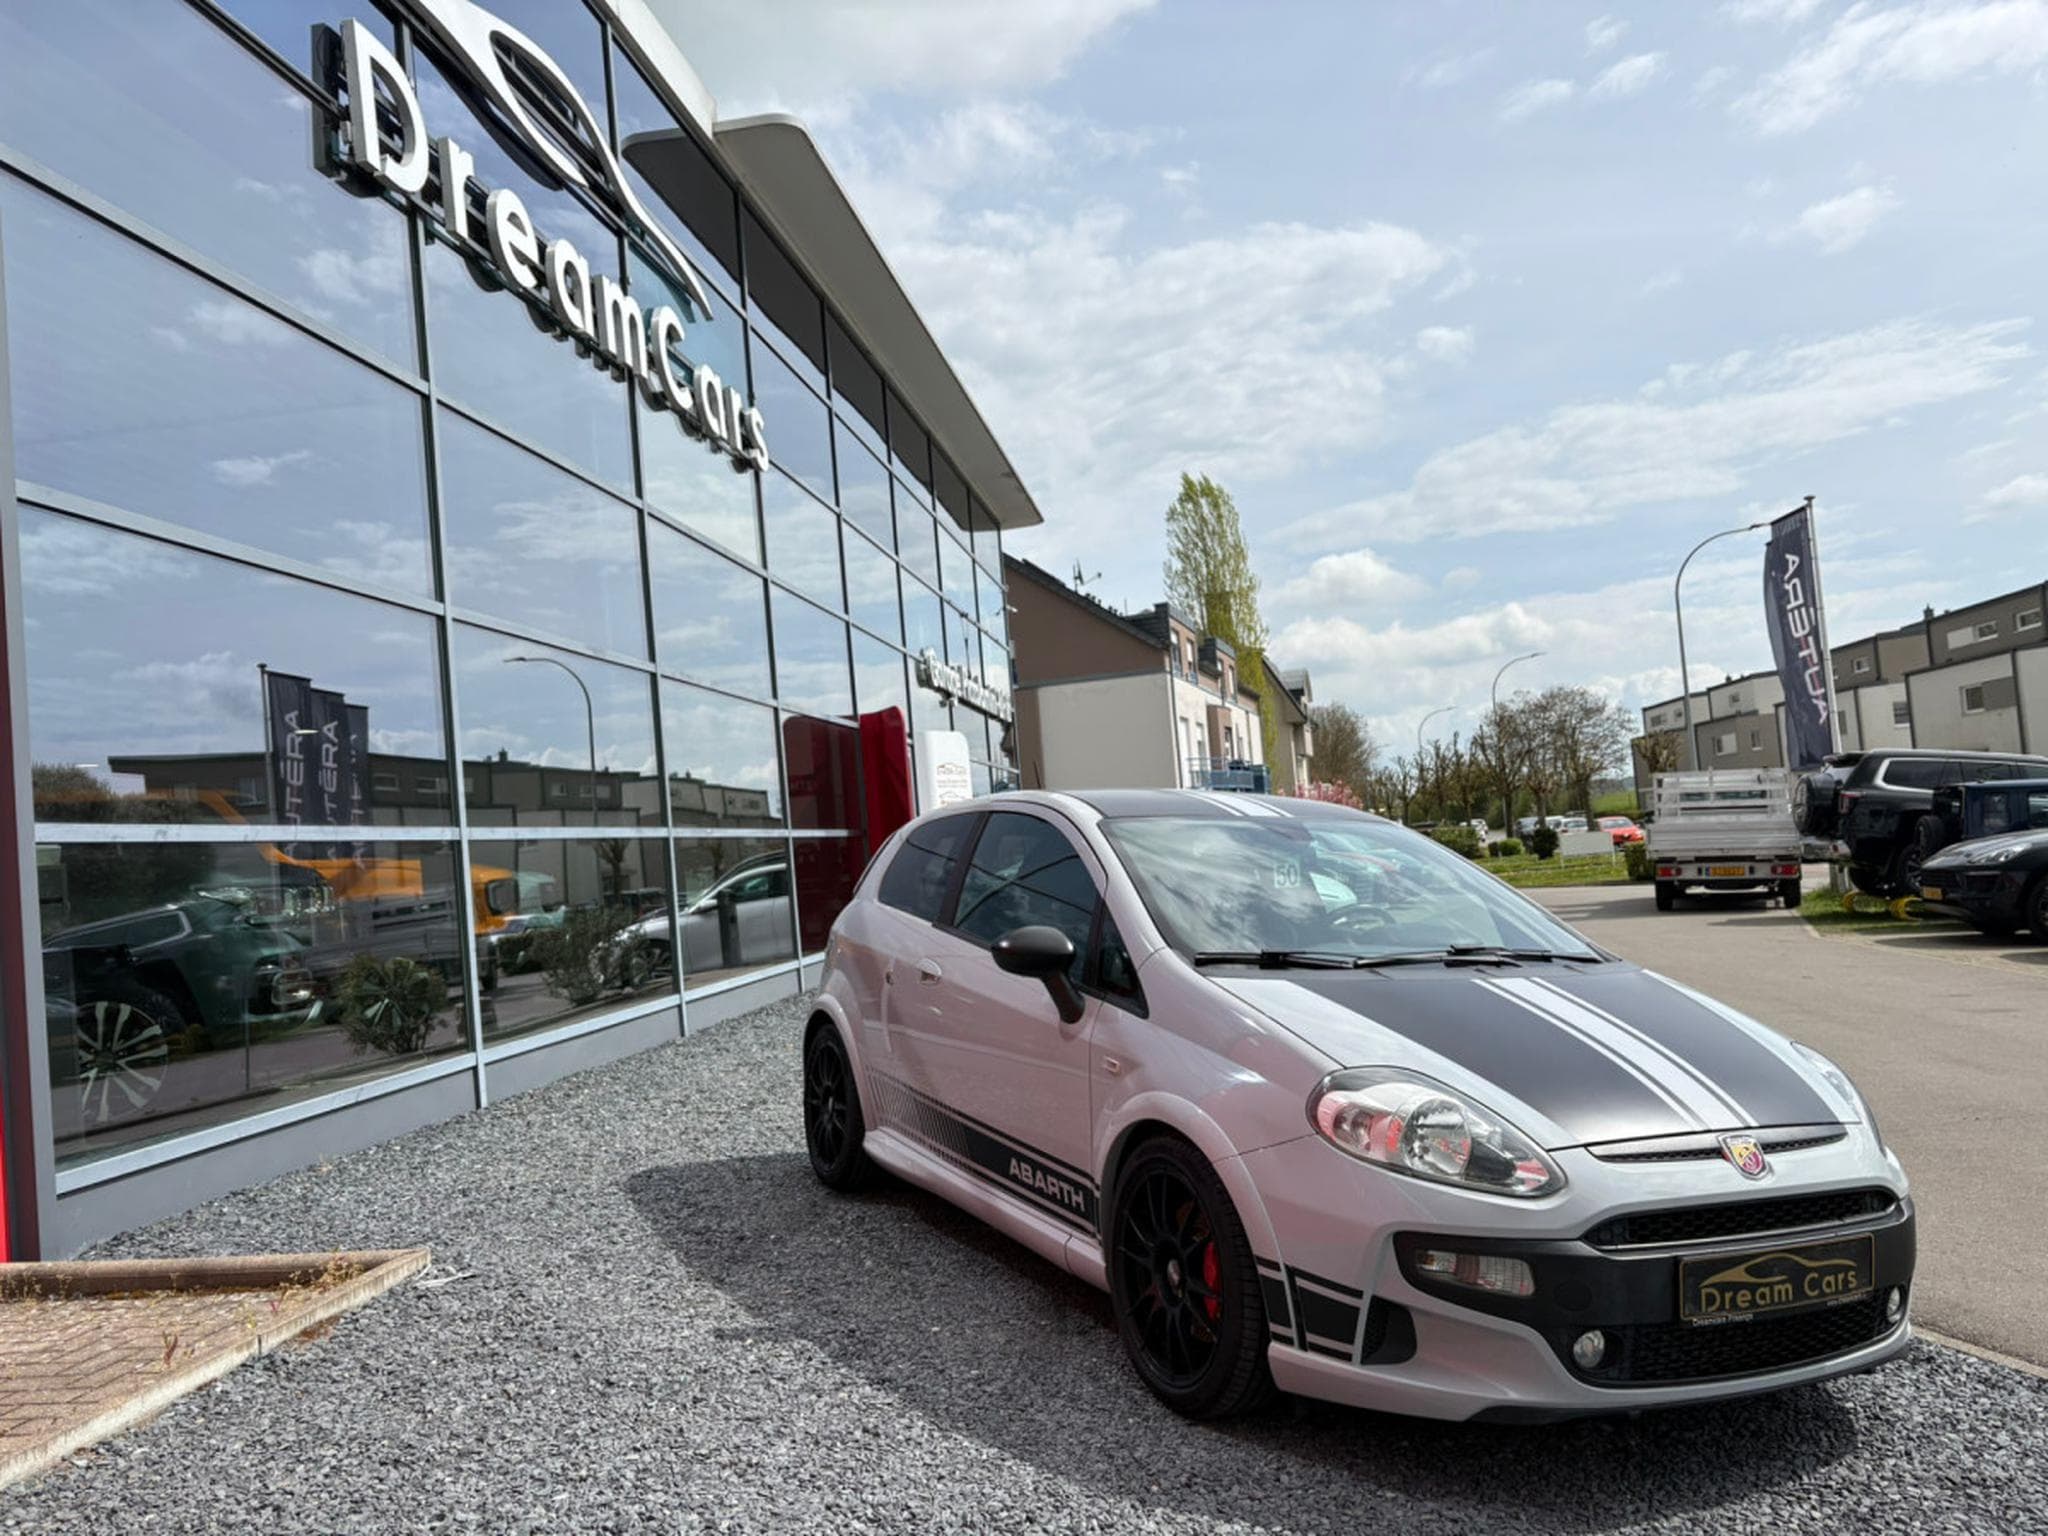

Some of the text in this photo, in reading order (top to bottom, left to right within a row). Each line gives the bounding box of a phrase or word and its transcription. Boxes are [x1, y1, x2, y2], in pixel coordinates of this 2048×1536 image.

[341, 18, 769, 471] DreamCars
[1276, 863, 1298, 886] 50
[1009, 1157, 1085, 1212] ABARTH
[1700, 1283, 1793, 1313] Dream
[1804, 1269, 1858, 1297] Cars
